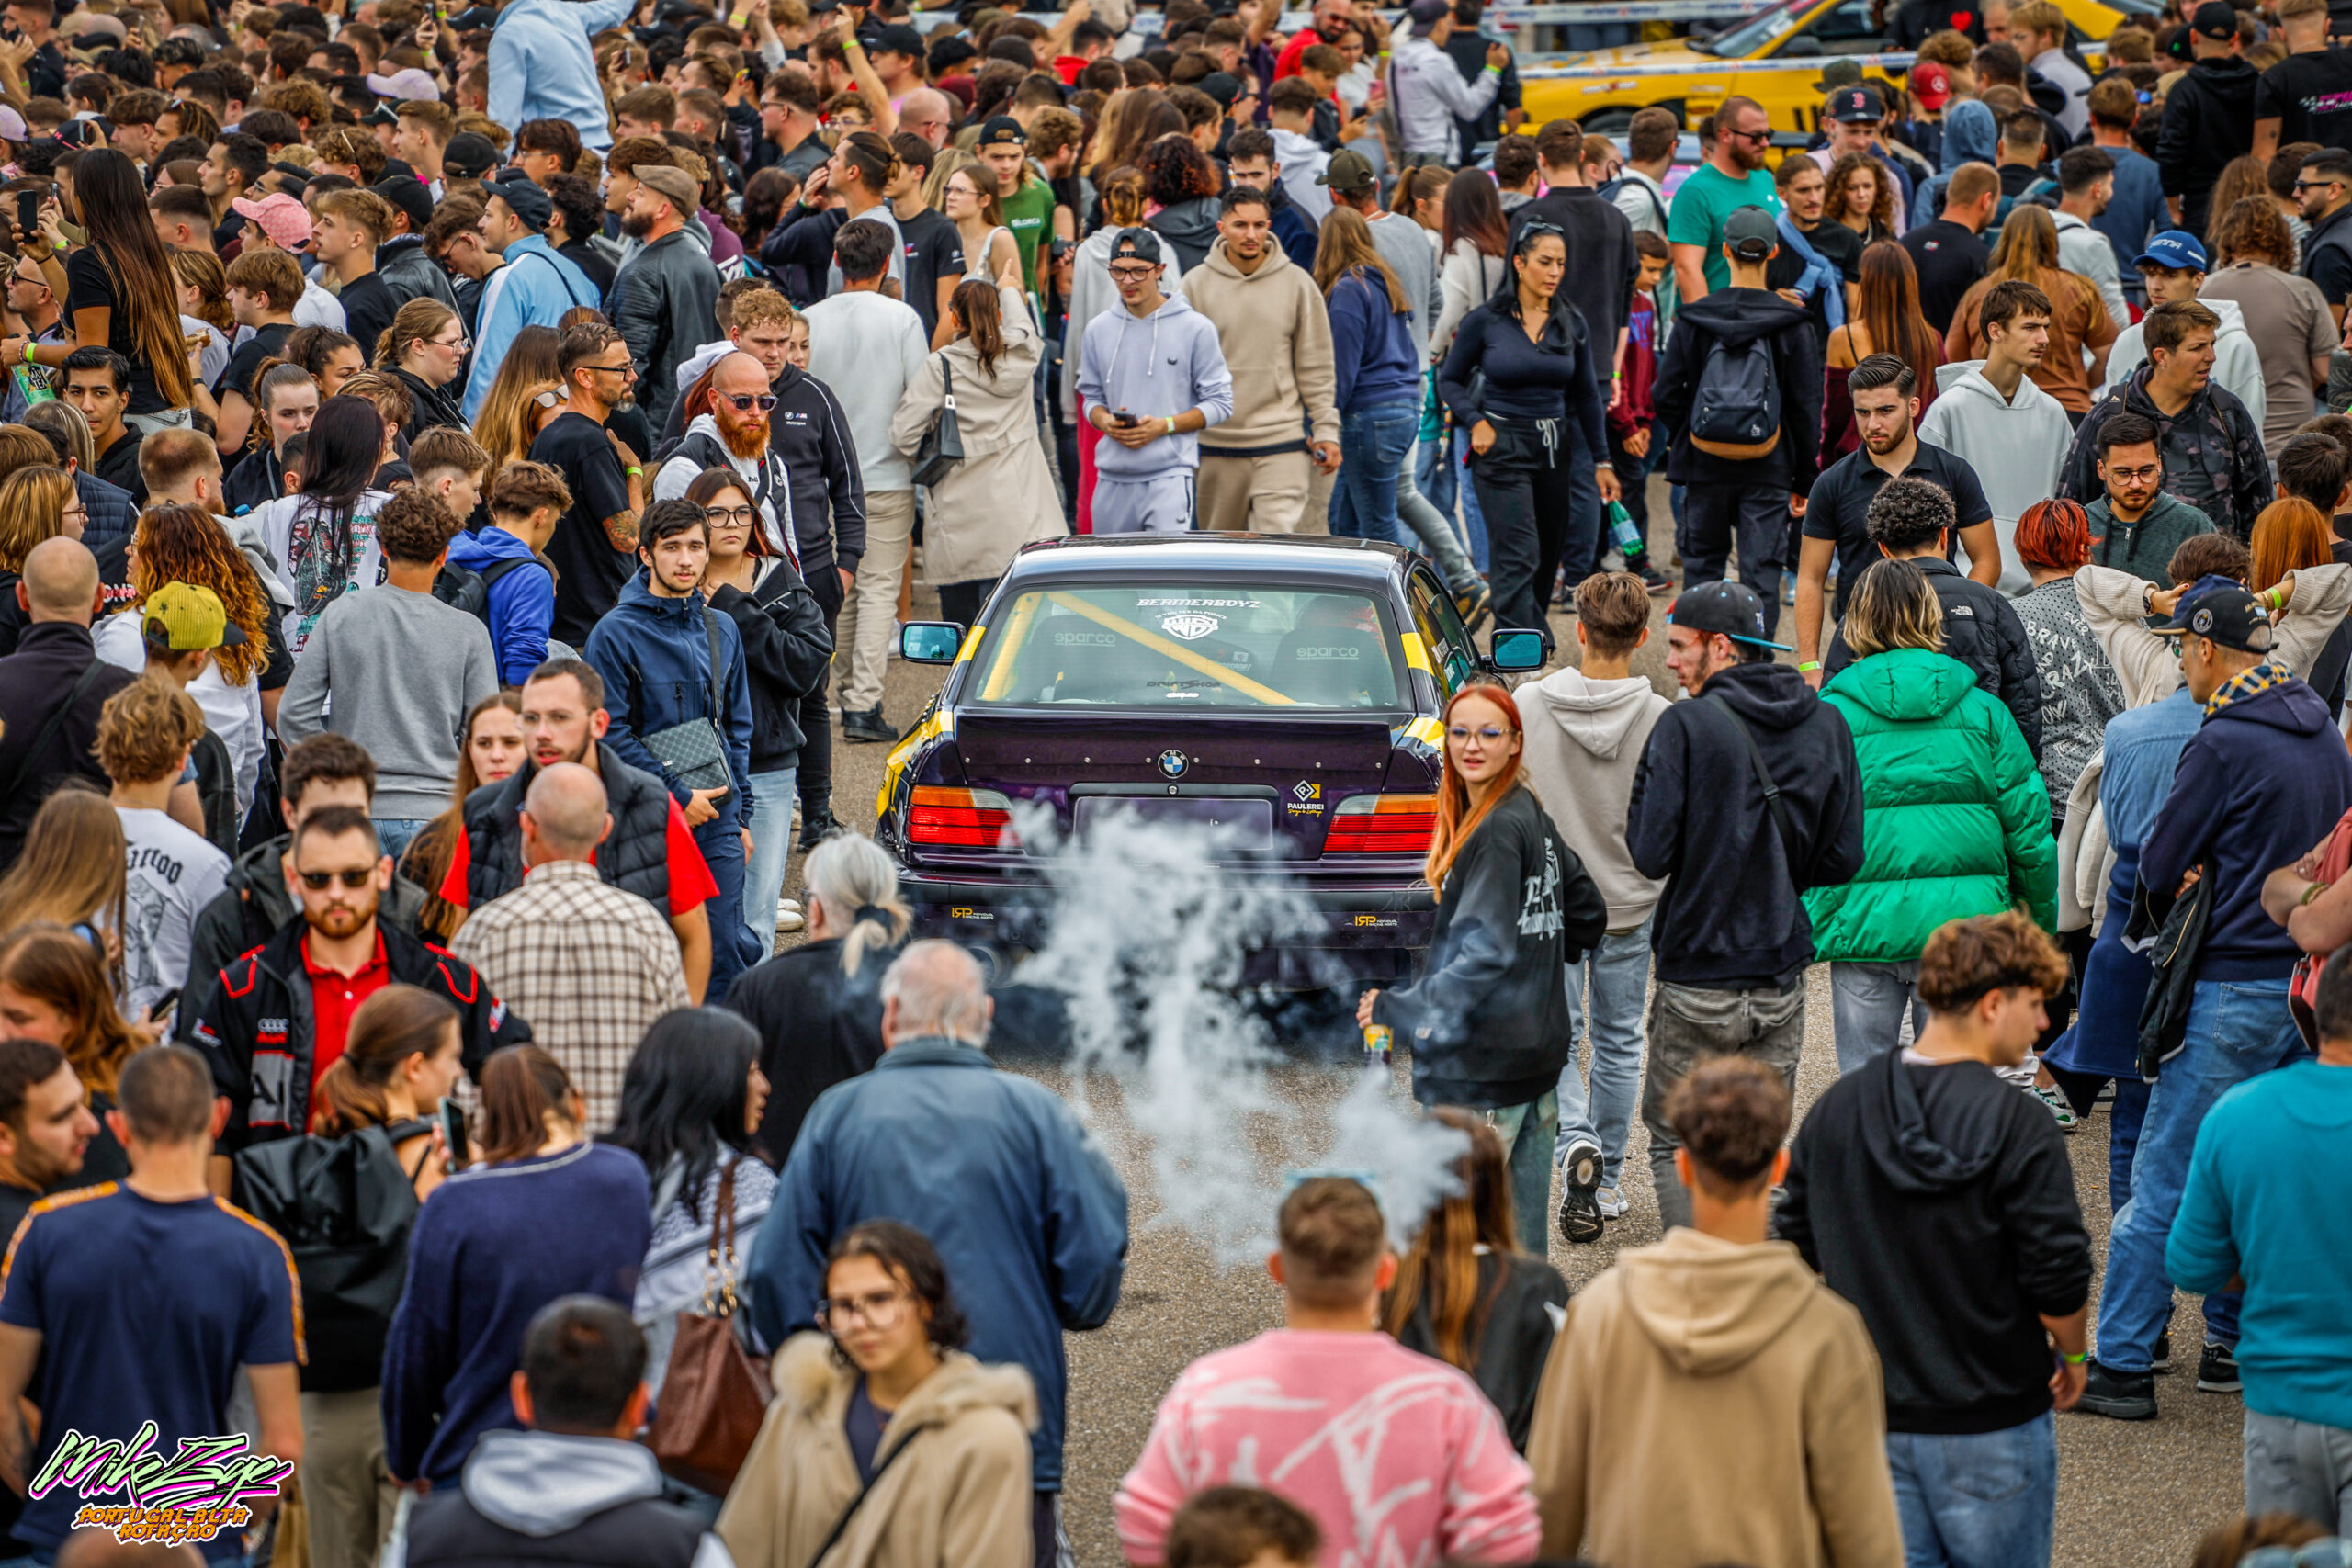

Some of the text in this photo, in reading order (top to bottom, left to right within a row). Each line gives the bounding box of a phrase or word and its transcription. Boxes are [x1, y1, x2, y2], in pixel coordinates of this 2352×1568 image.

[1852, 92, 1866, 108] B
[1204, 610, 1228, 620] POLICE
[1054, 632, 1116, 647] sparco
[2026, 620, 2079, 650] BRAVE
[1295, 646, 1359, 660] sparco
[1287, 802, 1325, 810] PAULEREI
